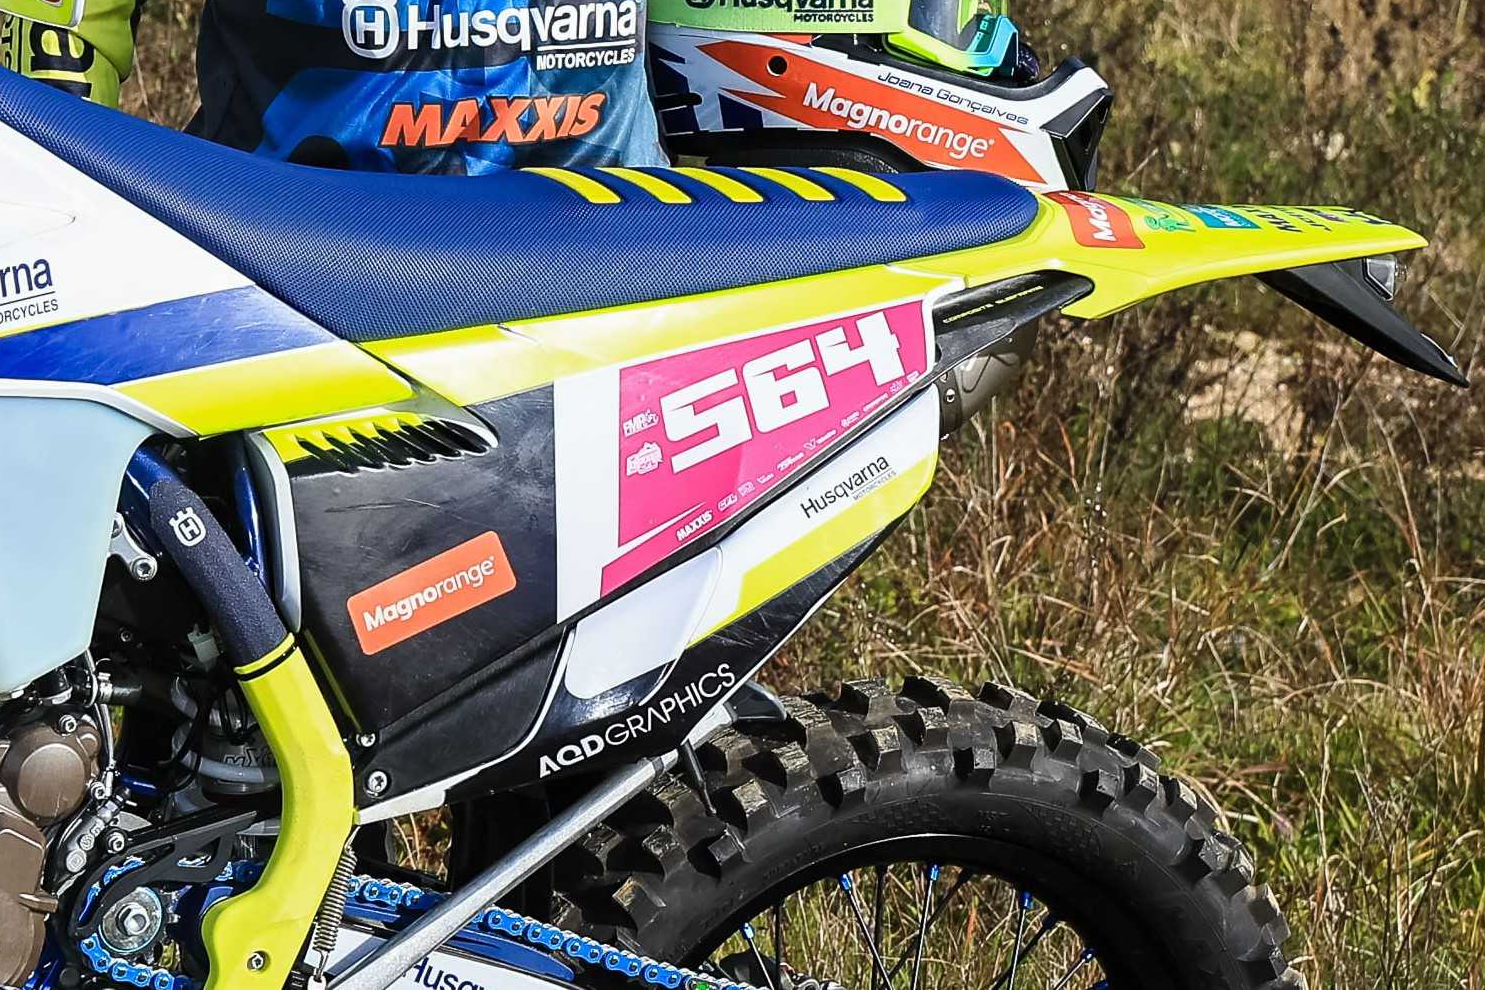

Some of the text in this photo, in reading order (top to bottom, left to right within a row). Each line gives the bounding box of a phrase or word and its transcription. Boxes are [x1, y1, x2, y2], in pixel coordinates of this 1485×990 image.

[792, 12, 875, 23] MOTORCYCLES
[536, 47, 636, 72] MOTORCYCLES
[379, 92, 607, 147] MAXXIS
[802, 82, 991, 160] Magnorange
[877, 72, 1030, 126] Joana Gonçalves
[659, 311, 908, 474] 564
[799, 456, 890, 519] Husqvarna
[675, 509, 714, 542] MAXXIS
[362, 555, 495, 632] Magnorange
